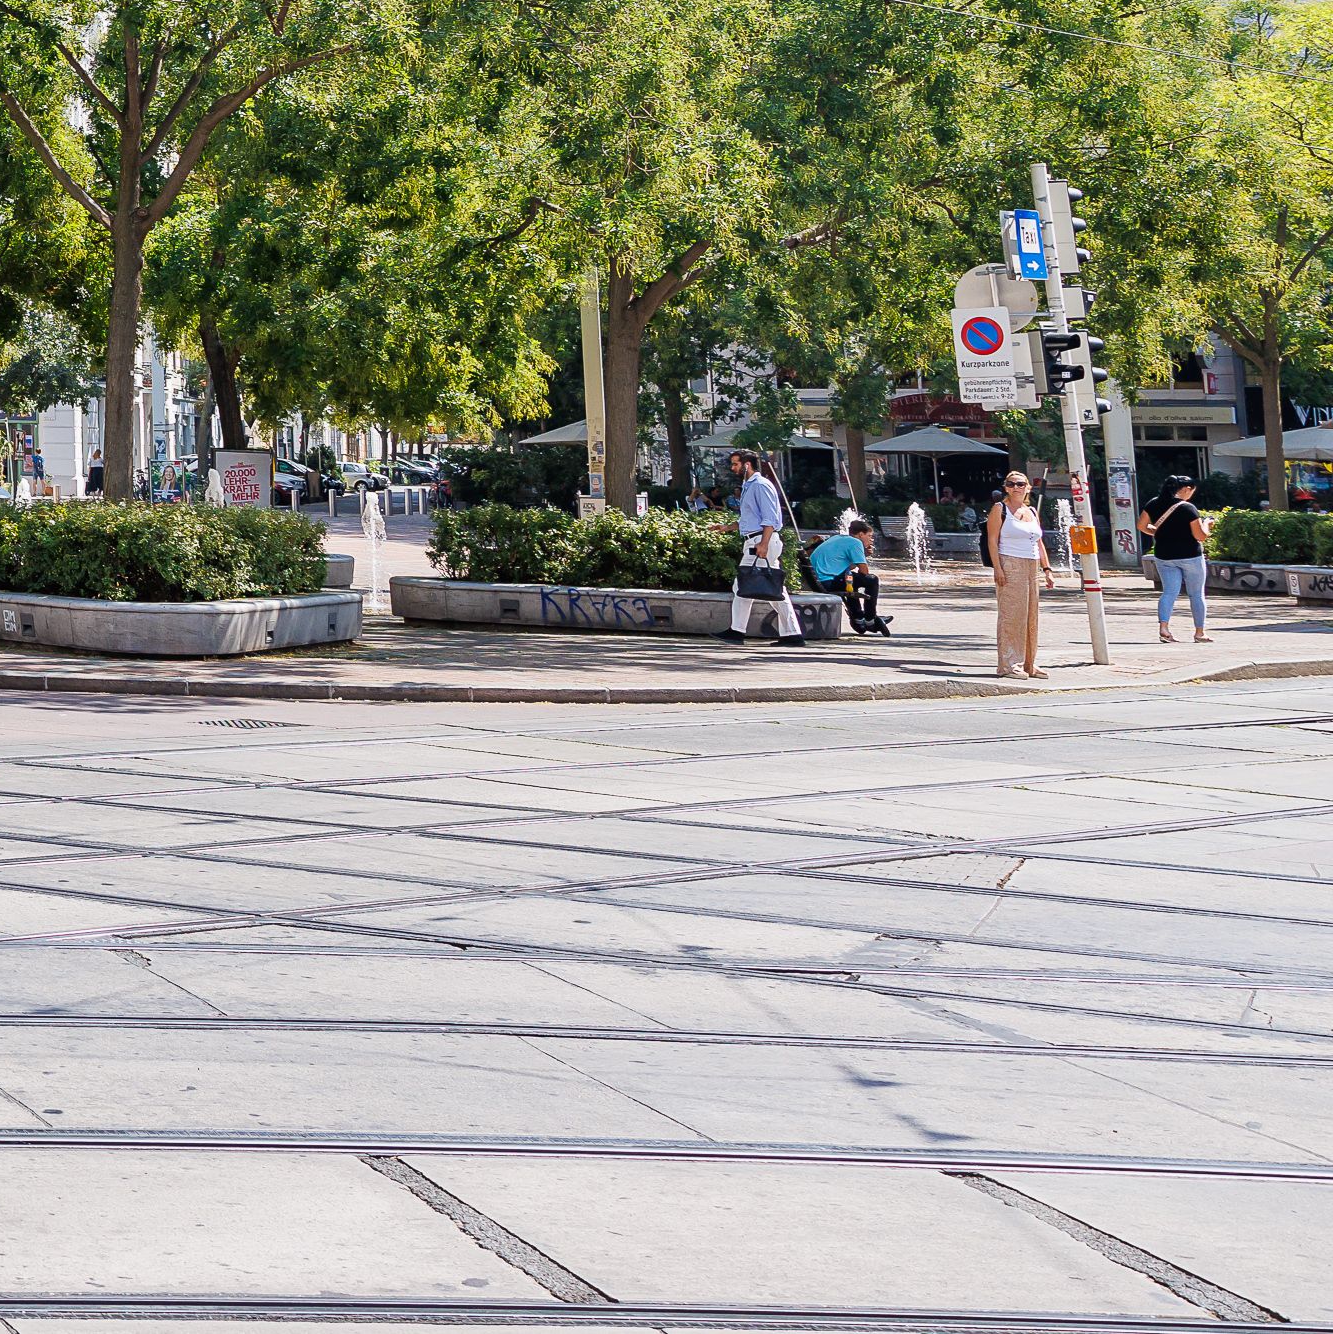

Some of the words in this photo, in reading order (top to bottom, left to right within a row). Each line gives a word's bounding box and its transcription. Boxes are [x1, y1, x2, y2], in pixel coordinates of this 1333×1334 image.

[1021, 226, 1037, 245] Taxi
[961, 360, 1010, 369] Kurzparkzone
[224, 468, 257, 478] 20.000
[224, 476, 252, 486] LEHR-
[232, 491, 261, 502] MEHR
